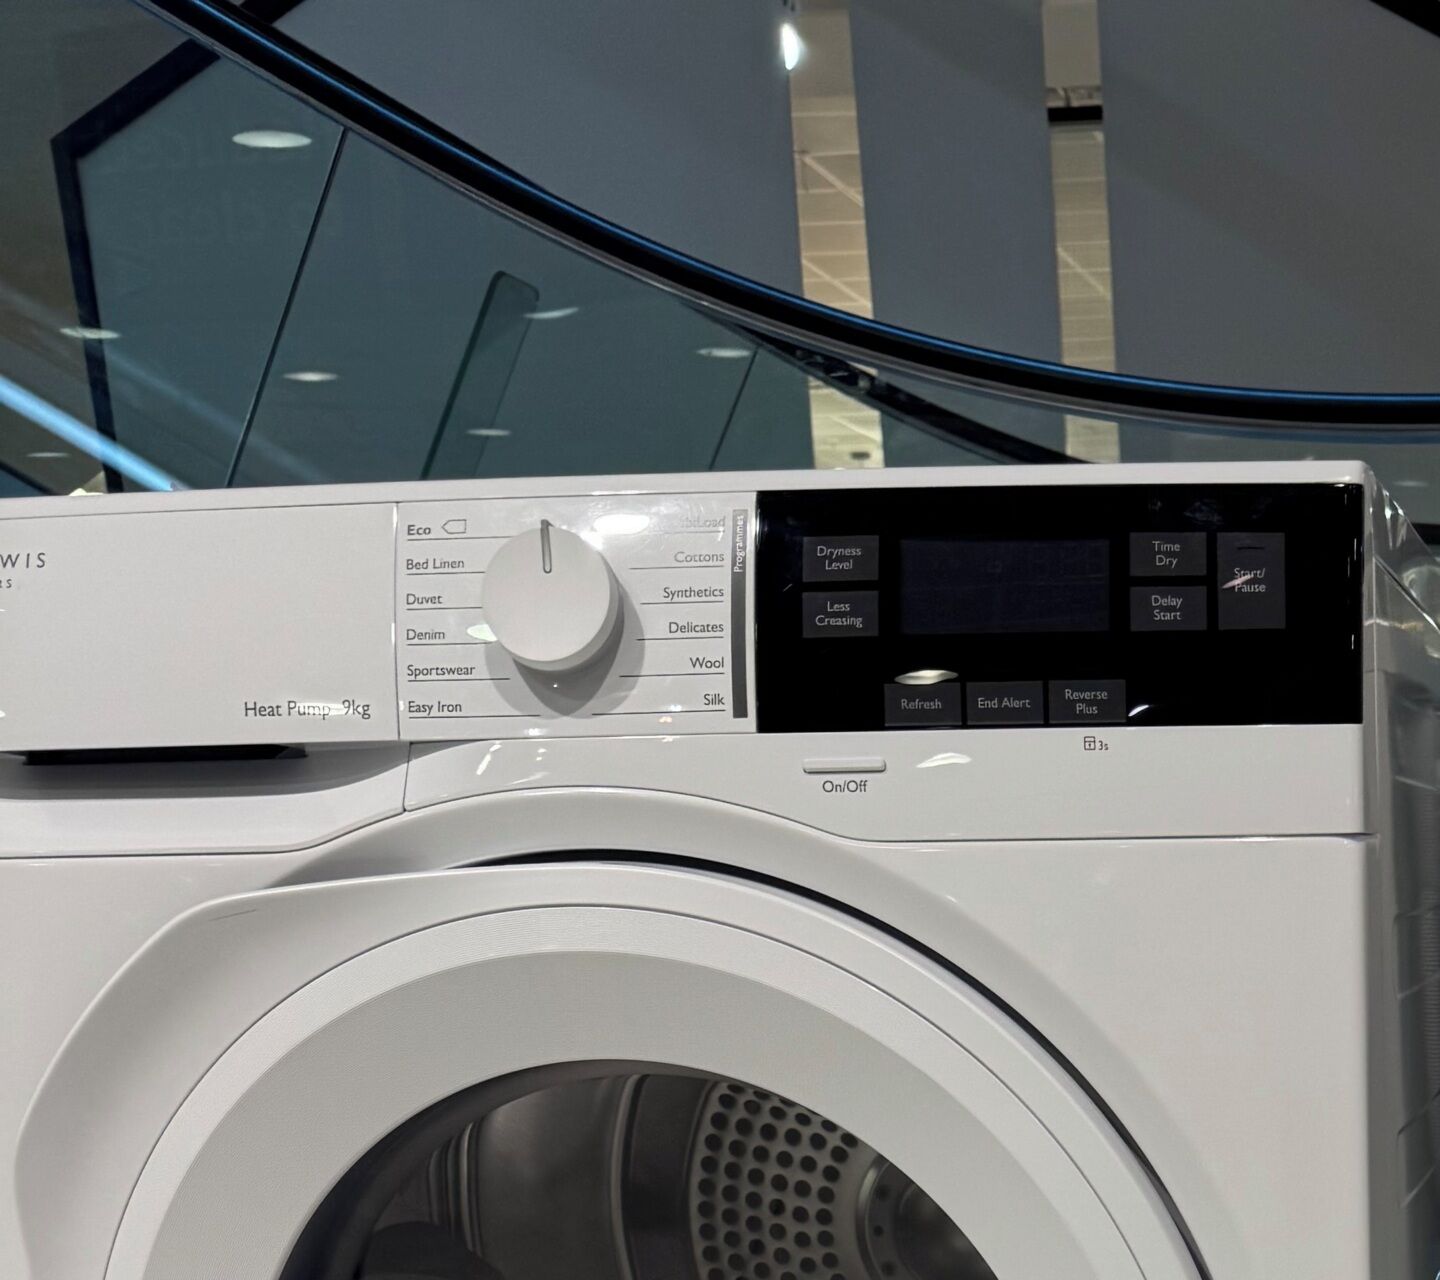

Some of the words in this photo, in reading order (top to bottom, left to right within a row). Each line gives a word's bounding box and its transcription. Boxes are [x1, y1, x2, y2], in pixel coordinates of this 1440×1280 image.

[407, 524, 431, 535] Eco
[733, 514, 745, 573] Programmes
[1152, 540, 1181, 552] Time
[674, 551, 725, 563] Cottons
[817, 545, 862, 559] Dryness
[406, 558, 429, 570] Bed
[433, 557, 465, 569] Linen
[825, 559, 853, 570] Level
[1155, 554, 1179, 568] Dry
[406, 593, 443, 605] Duvet
[663, 586, 724, 601] Synthetics
[827, 601, 851, 612] Less
[1151, 595, 1183, 609] Delay
[815, 614, 864, 629] Creasing
[1153, 610, 1182, 621] Start
[668, 621, 724, 634] Delicates
[406, 628, 446, 641] Denim
[689, 656, 725, 669] Wool
[407, 664, 476, 679] Sportswear
[703, 693, 725, 706] Silk
[1065, 688, 1108, 700] Reverse
[408, 700, 434, 715] Easy
[437, 700, 463, 713] Iron
[901, 698, 942, 710] Refresh
[978, 697, 999, 709] End
[1001, 696, 1031, 708] Alert
[1075, 702, 1099, 715] Plus
[244, 701, 282, 717] Heat
[287, 700, 331, 720] Pump
[342, 699, 371, 720] 9kg
[1097, 740, 1109, 751] 3s
[822, 779, 868, 793] On/Off
